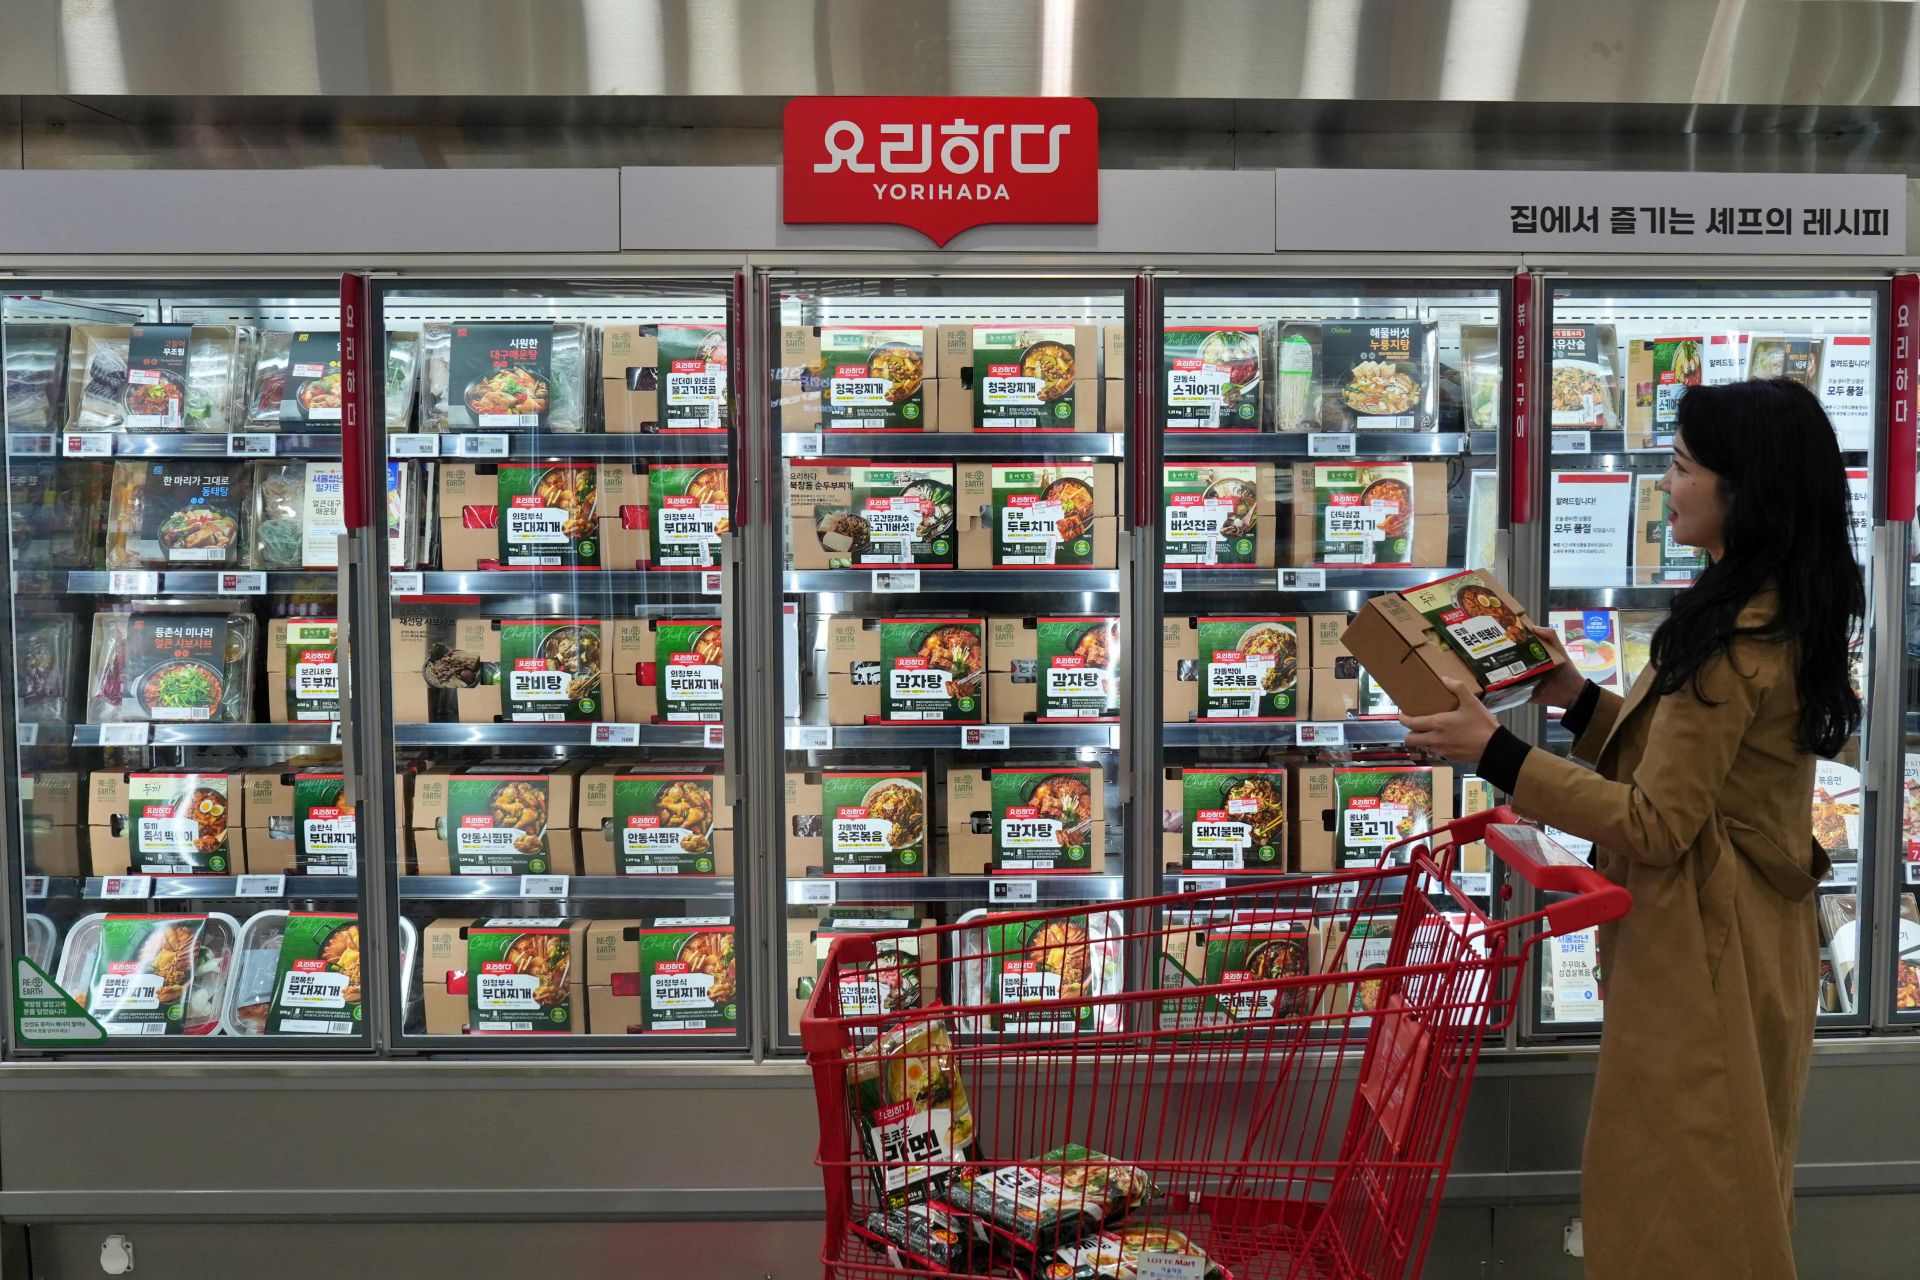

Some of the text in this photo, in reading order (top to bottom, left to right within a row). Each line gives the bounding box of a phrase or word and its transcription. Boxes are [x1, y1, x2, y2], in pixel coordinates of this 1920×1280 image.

[814, 118, 1070, 174] 요리하다
[873, 184, 1010, 200] YORIHADA
[1511, 206, 1888, 236] 집에서 즐기는 셰프의 레시피
[1370, 328, 1409, 338] 해물버섯
[510, 338, 538, 349] 시원한
[1370, 340, 1409, 350] 누룽지탕
[1830, 359, 1870, 368] 알려드립니다!
[1896, 304, 1909, 422] 요리하다
[672, 377, 692, 385] 산더미
[672, 386, 716, 395] 불고기전골
[835, 382, 883, 395] 청국장찌개
[988, 382, 1036, 394] 청국장찌개
[1173, 384, 1219, 395] 스키야키
[1827, 386, 1864, 396] 모두 품절
[164, 475, 229, 486] 한 마리가 그대로
[814, 481, 854, 491] 순두부찌개
[202, 486, 229, 497] 동태탕
[1555, 497, 1596, 506] 알려드립니다!
[512, 512, 543, 520] 의정부식
[664, 513, 695, 521] 의정부식
[1008, 512, 1023, 520] 두부
[512, 522, 560, 534] 부대찌개
[664, 523, 713, 534] 부대찌개
[1008, 521, 1054, 532] 두루치기
[1171, 520, 1217, 531] 버섯전골
[1330, 520, 1375, 531] 두루치기
[1554, 523, 1591, 533] 모두 품절
[155, 627, 213, 638] 등촌식 미나리
[995, 633, 1014, 641] EARTH
[1477, 626, 1503, 642] 떡볶이
[670, 670, 701, 678] 의정부식
[302, 677, 338, 688] 두부찌
[515, 675, 562, 690] 갈비탕
[670, 679, 719, 690] 부대찌개
[895, 674, 942, 687] 감자탕
[1052, 673, 1098, 687] 감자탕
[1213, 675, 1257, 686] 숙주볶음
[1309, 783, 1328, 791] EARTH
[838, 823, 866, 831] 차돌박이
[1006, 824, 1052, 838] 감자탕
[1350, 821, 1394, 836] 불고기
[461, 832, 513, 844] 안동식찜닭
[628, 832, 680, 844] 안동식찜닭
[838, 832, 882, 842] 숙주볶음
[596, 945, 616, 953] EARTH
[482, 979, 513, 987] 의정부식
[656, 979, 687, 987] 의정부식
[23, 987, 43, 996] EARTH
[102, 985, 155, 999] 부대찌개
[288, 984, 341, 998] 부대찌개
[482, 987, 531, 999] 부대찌개
[656, 987, 705, 999] 부대찌개
[1147, 1257, 1195, 1267] LOTTE Mart
